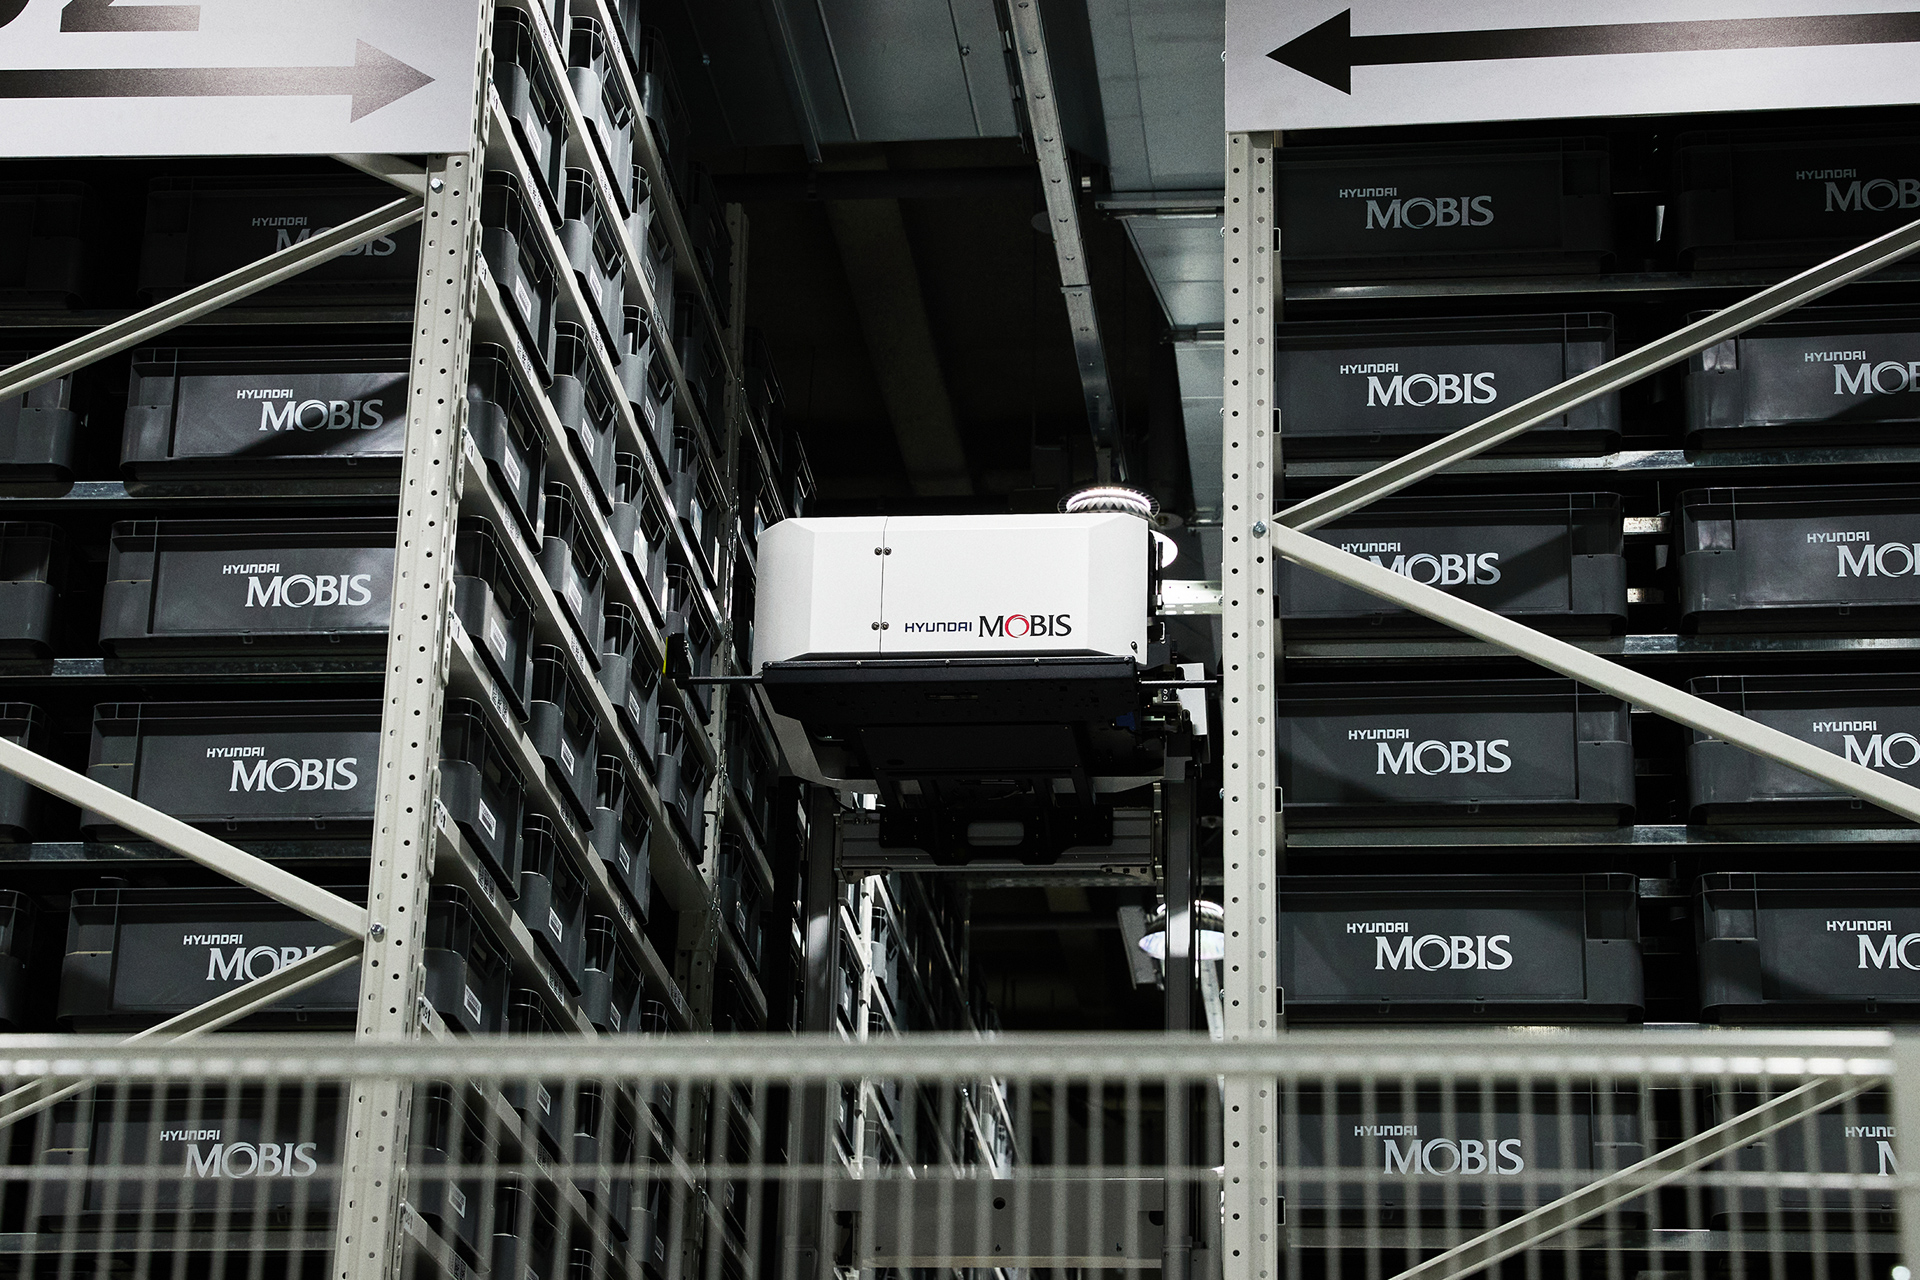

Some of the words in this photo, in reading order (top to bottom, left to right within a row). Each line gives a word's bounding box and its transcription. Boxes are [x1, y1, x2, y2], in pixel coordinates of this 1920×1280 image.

[1795, 168, 1857, 180] HYUNDAI
[1339, 187, 1398, 199] HYUNDAI
[1365, 196, 1494, 230] MOBIS
[252, 217, 310, 230] HYUNDAI
[274, 226, 398, 257] MIS
[1804, 350, 1866, 363] HYUNDAI
[1340, 362, 1399, 375] HYUNDAI
[236, 389, 294, 399] HYUNDAI
[1366, 372, 1497, 407] MOBIS
[258, 399, 384, 432] MOBIS
[1806, 531, 1870, 544] HYUNDAI
[1341, 542, 1401, 553] HYUNDAI
[222, 563, 280, 575] HYUNDAI
[246, 574, 373, 608] MOBIS
[905, 621, 972, 633] HYUNDAI
[979, 614, 1071, 638] MOBIS
[1812, 720, 1877, 733] HYUNDAI
[1348, 728, 1410, 740] HYUNDAI
[206, 746, 265, 758] HYUNDAI
[1376, 739, 1511, 775] MOBIS
[229, 757, 357, 792] MOBIS
[1346, 922, 1409, 934] HYUNDAI
[1826, 920, 1892, 932] HYUNDAI
[183, 934, 243, 945] HYUNDAI
[1376, 935, 1512, 971] MOBIS
[206, 946, 336, 981] MOB
[159, 1129, 221, 1142] HYUNDAI
[1354, 1125, 1418, 1137] HYUNDAI
[1845, 1126, 1897, 1138] HYUND
[184, 1142, 317, 1178] MOBIS
[1383, 1138, 1524, 1176] MOBIS
